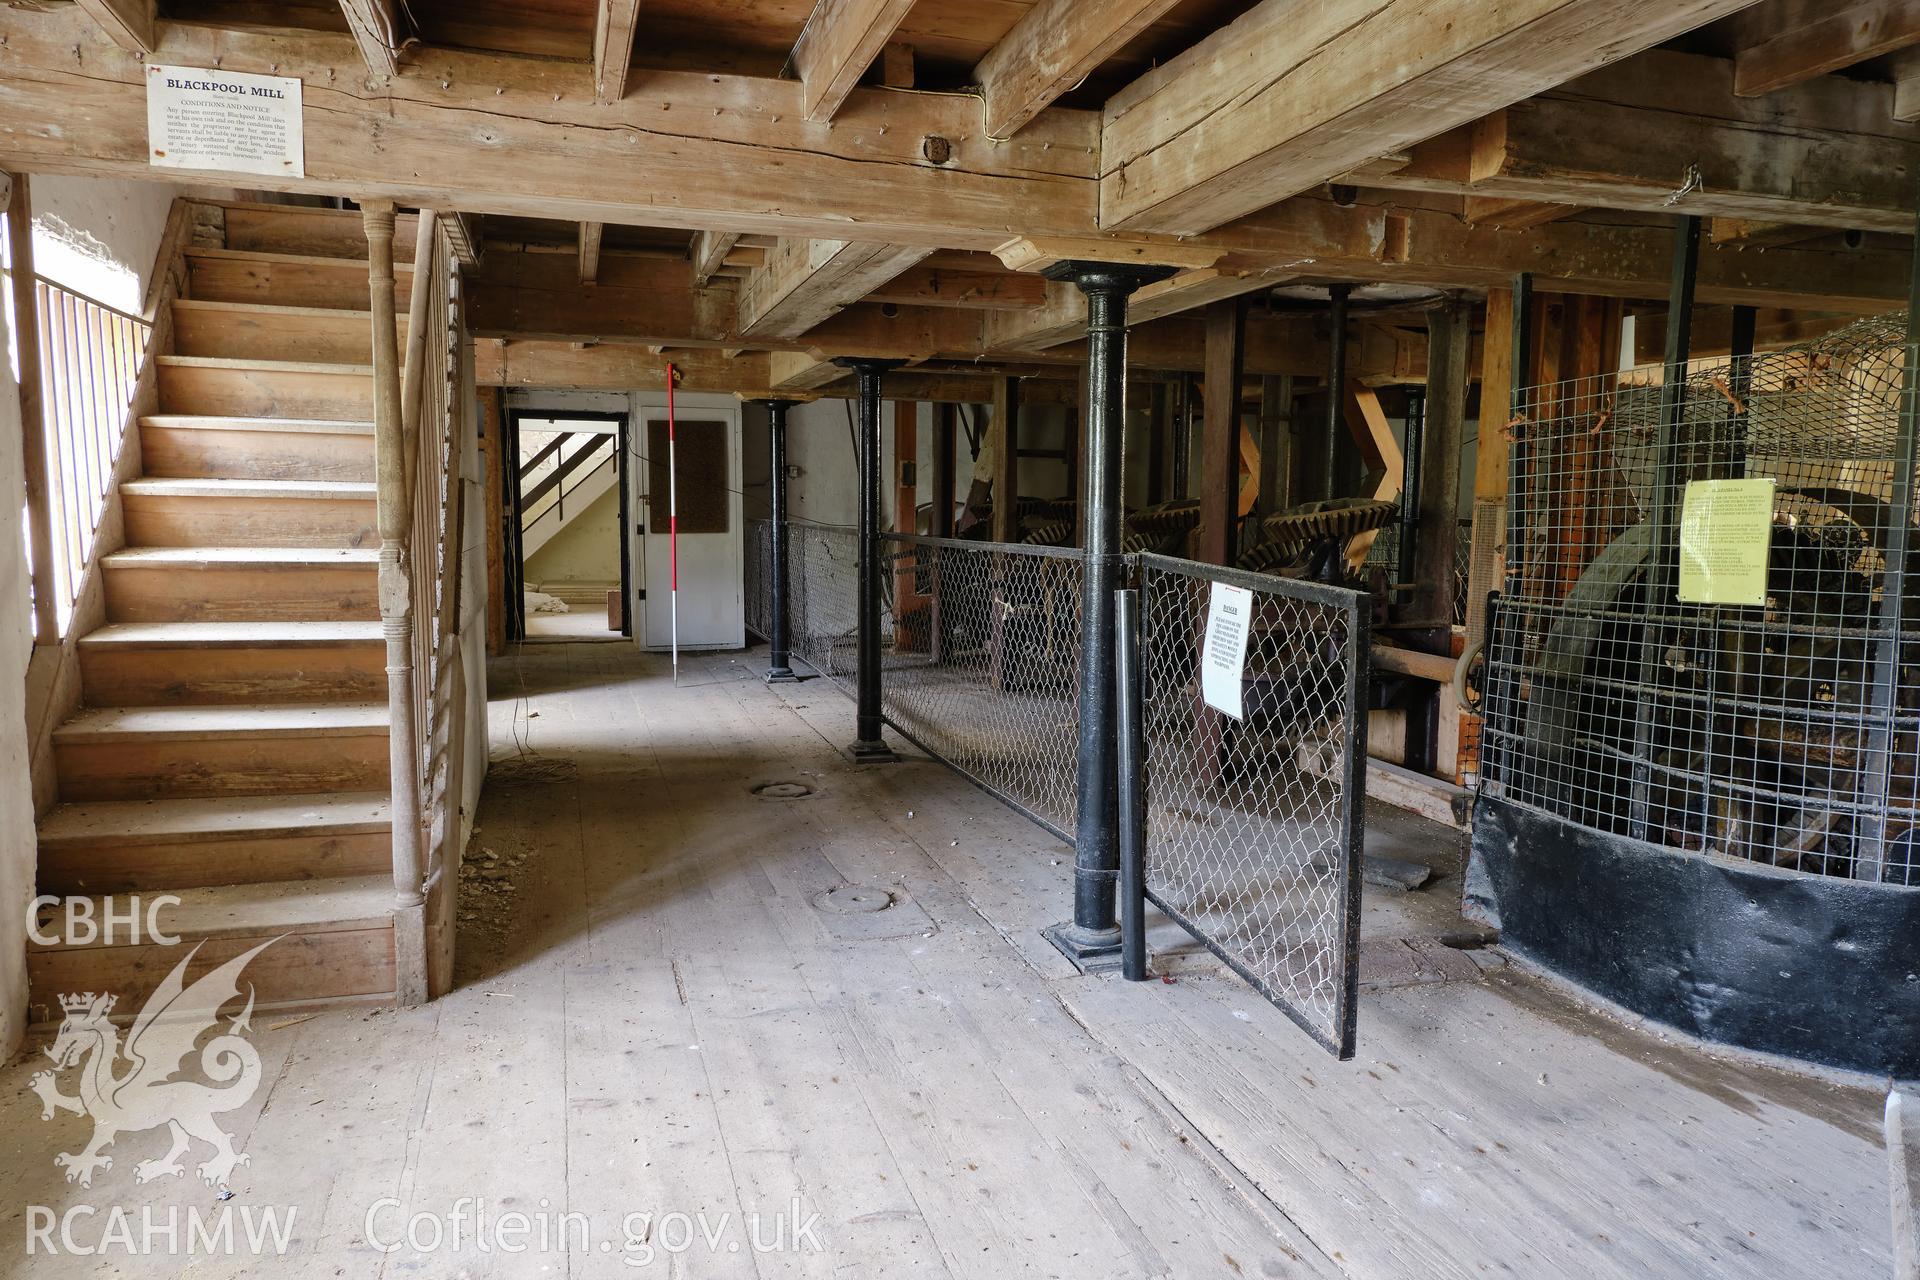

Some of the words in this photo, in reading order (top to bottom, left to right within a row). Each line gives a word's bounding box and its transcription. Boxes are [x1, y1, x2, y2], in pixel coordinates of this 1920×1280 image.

[167, 79, 246, 95] BLACKPOOL
[251, 86, 284, 99] MILL
[181, 99, 225, 108] CONDITIONS
[243, 105, 270, 113] NOTICE
[228, 111, 256, 120] Blackpool
